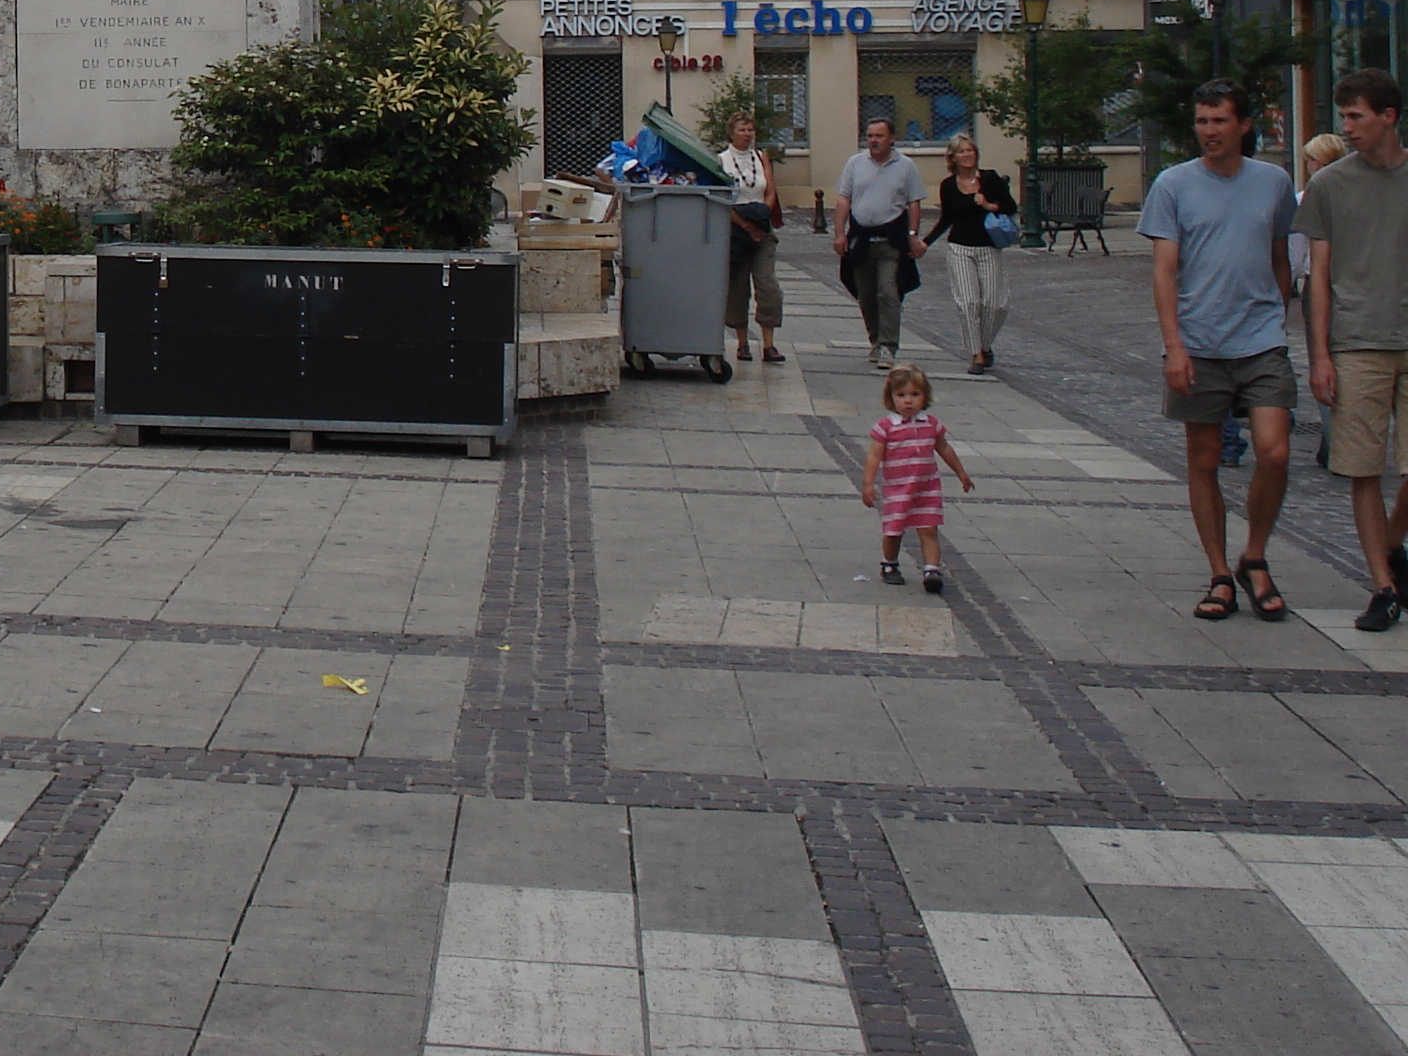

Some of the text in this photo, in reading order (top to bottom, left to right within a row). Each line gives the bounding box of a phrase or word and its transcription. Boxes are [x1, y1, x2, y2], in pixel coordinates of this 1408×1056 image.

[80, 16, 170, 27] VENDEMIAIRE
[174, 15, 192, 26] AN
[197, 15, 206, 26] X
[540, 15, 686, 37] ANNONCES
[911, 11, 1023, 33] VOYAGE
[82, 57, 178, 69] DU CONSULAT
[653, 55, 698, 71] cble
[79, 79, 96, 90] DE
[264, 274, 343, 291] MANUT
